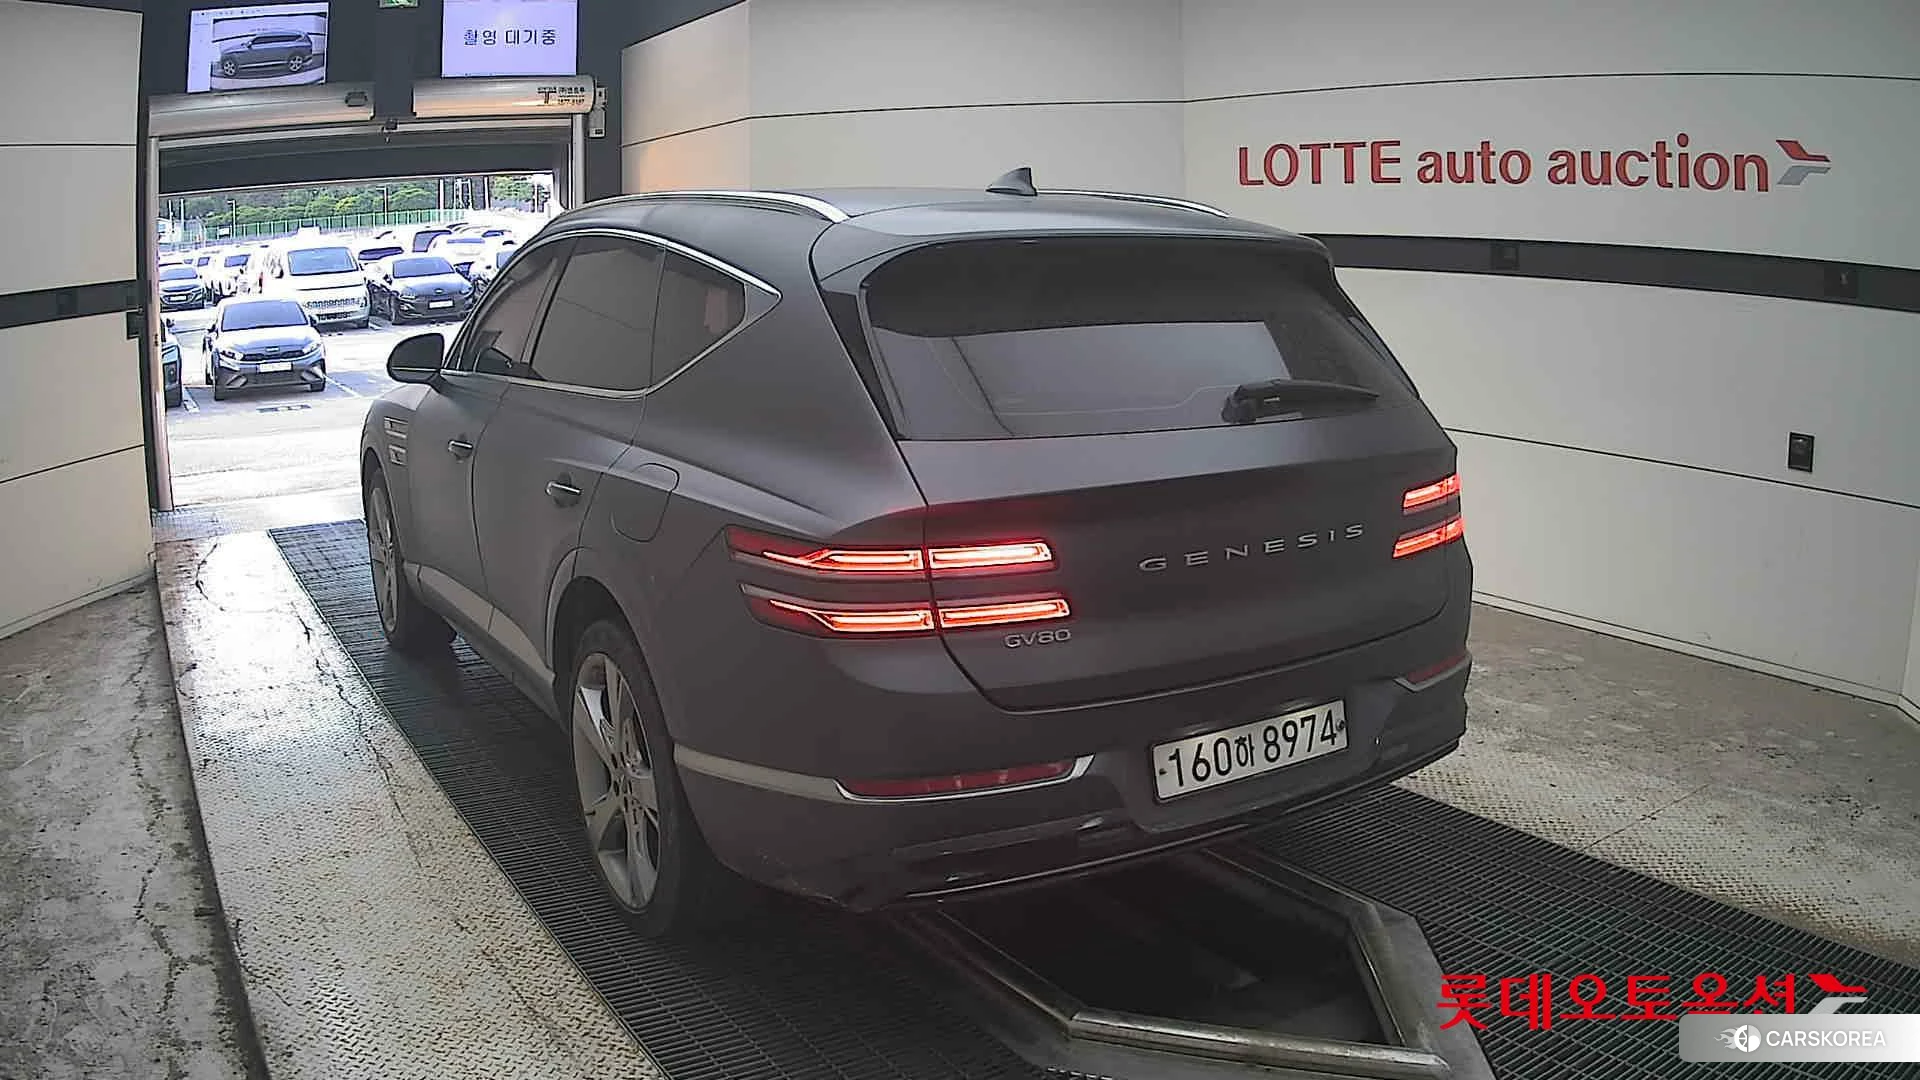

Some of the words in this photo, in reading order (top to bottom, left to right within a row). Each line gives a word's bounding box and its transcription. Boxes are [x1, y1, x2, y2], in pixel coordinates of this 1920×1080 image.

[505, 29, 556, 46] 대기중
[1238, 140, 1401, 187] LOTTE
[1416, 140, 1532, 185] auto
[1547, 133, 1769, 192] auction
[1138, 522, 1366, 572] GENESIS
[1003, 628, 1072, 649] GV80
[1263, 709, 1337, 763] 8974
